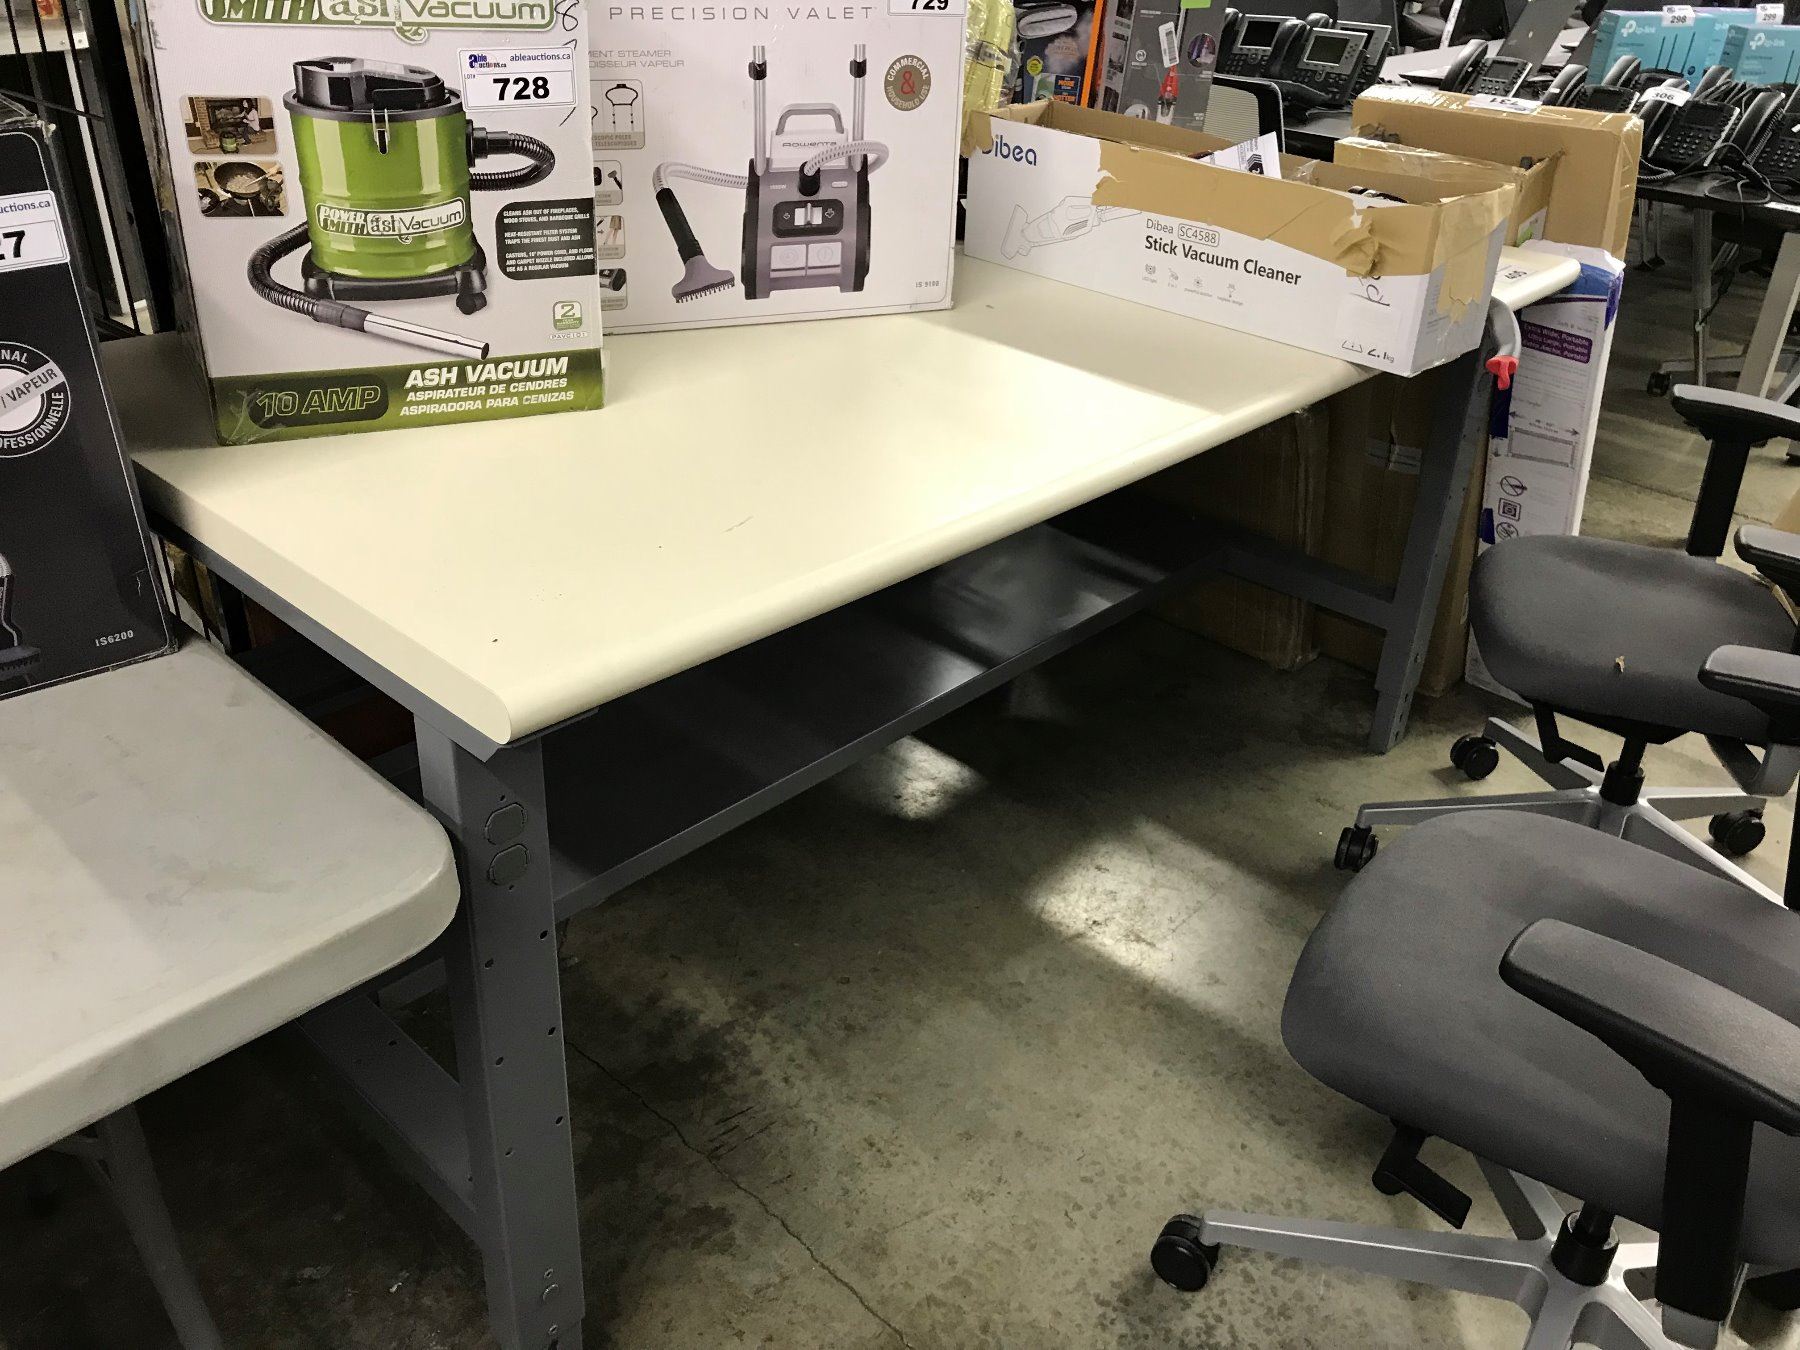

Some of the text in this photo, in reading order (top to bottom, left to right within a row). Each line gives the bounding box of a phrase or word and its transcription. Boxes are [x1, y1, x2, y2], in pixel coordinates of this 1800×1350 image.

[609, 6, 873, 20] PRECISION VALET
[510, 52, 571, 62] ableauctions.ca
[617, 50, 672, 58] STEAMER
[639, 60, 685, 68] VAPEUR
[887, 57, 930, 81] COMMERCIAL
[492, 76, 550, 101] 728
[901, 70, 916, 94] &
[886, 86, 920, 109] HOUSEHOLD
[319, 206, 366, 223] POWER
[399, 210, 462, 231] Vacuum
[1146, 218, 1217, 244] Dibea SC4588
[1144, 235, 1302, 286] Stick Vacuum Cleaner
[560, 304, 576, 318] 2
[403, 356, 569, 389] ASH VACUUM
[6, 368, 58, 402] VAPEUR
[406, 378, 568, 402] ASPIRATEUR DE CENDRES
[256, 385, 381, 418] 10 AMP
[400, 390, 575, 417] ASPIRADORA PARA CENIZAS
[95, 630, 134, 647] IS6200
